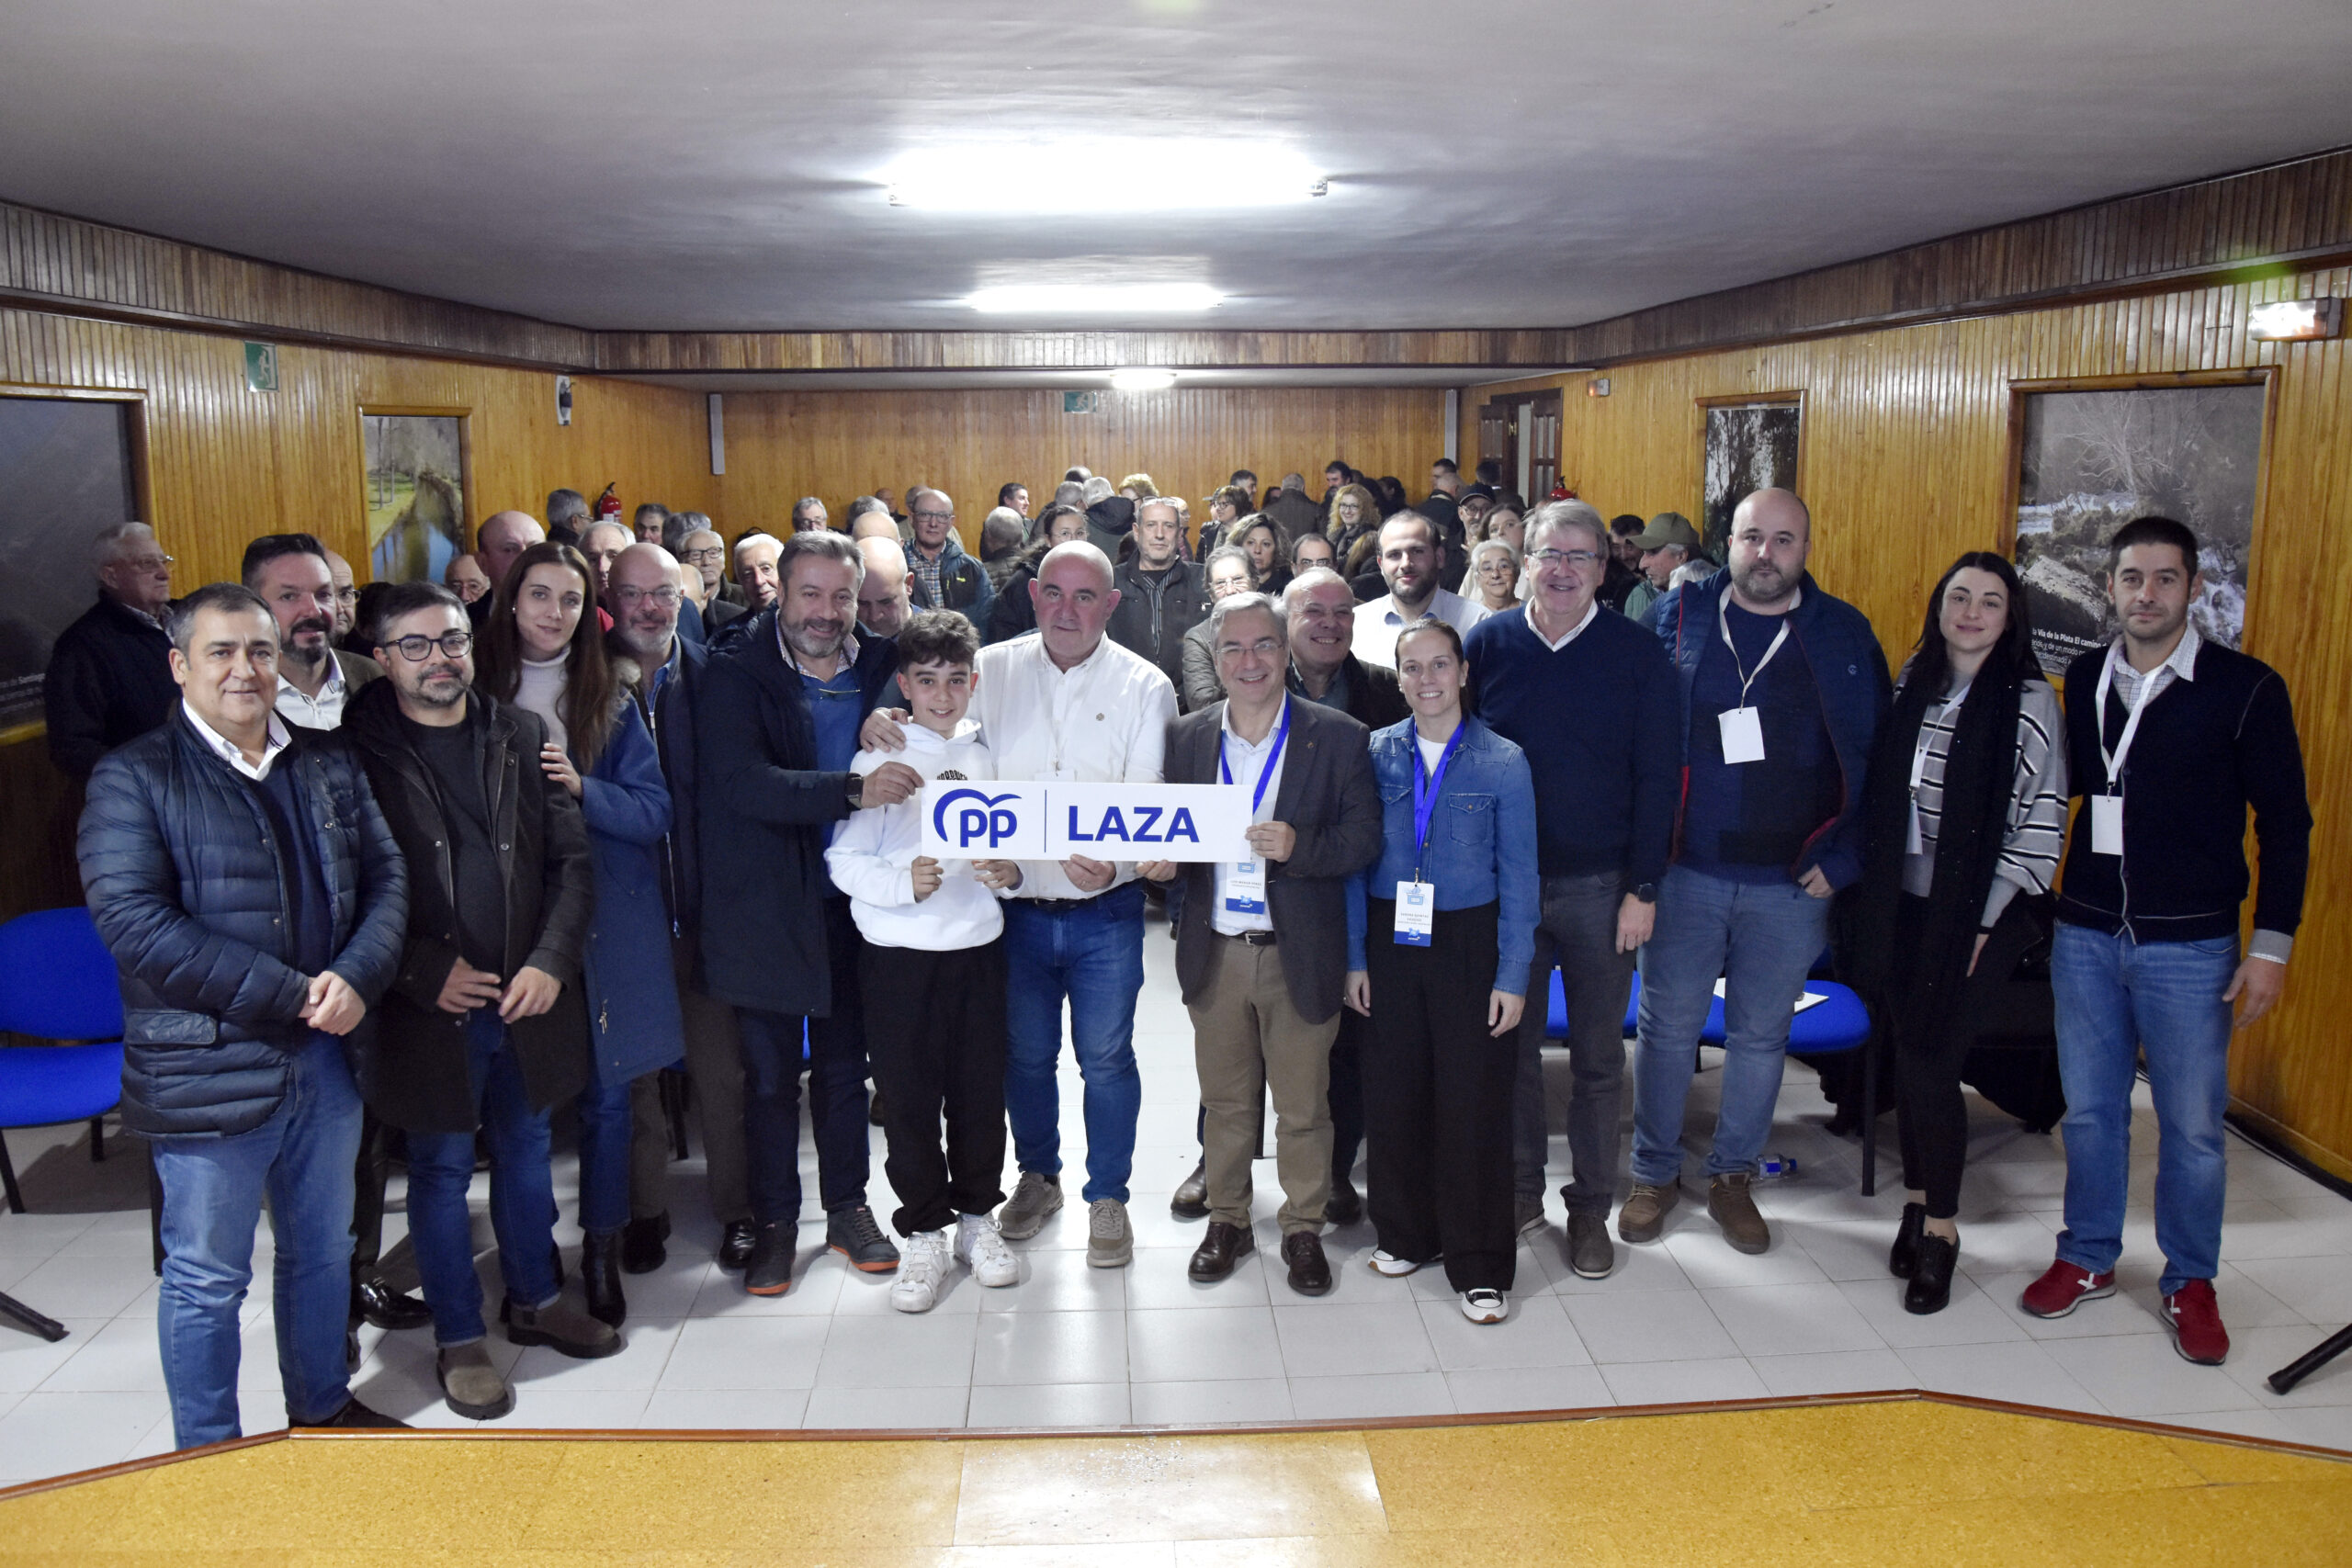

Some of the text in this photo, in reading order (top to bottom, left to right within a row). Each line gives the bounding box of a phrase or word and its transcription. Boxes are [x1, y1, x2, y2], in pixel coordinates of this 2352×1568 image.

[2046, 630, 2053, 638] de
[2060, 634, 2074, 643] Plata
[2074, 637, 2080, 645] El
[2080, 639, 2101, 649] camino
[1069, 806, 1199, 842] LAZA
